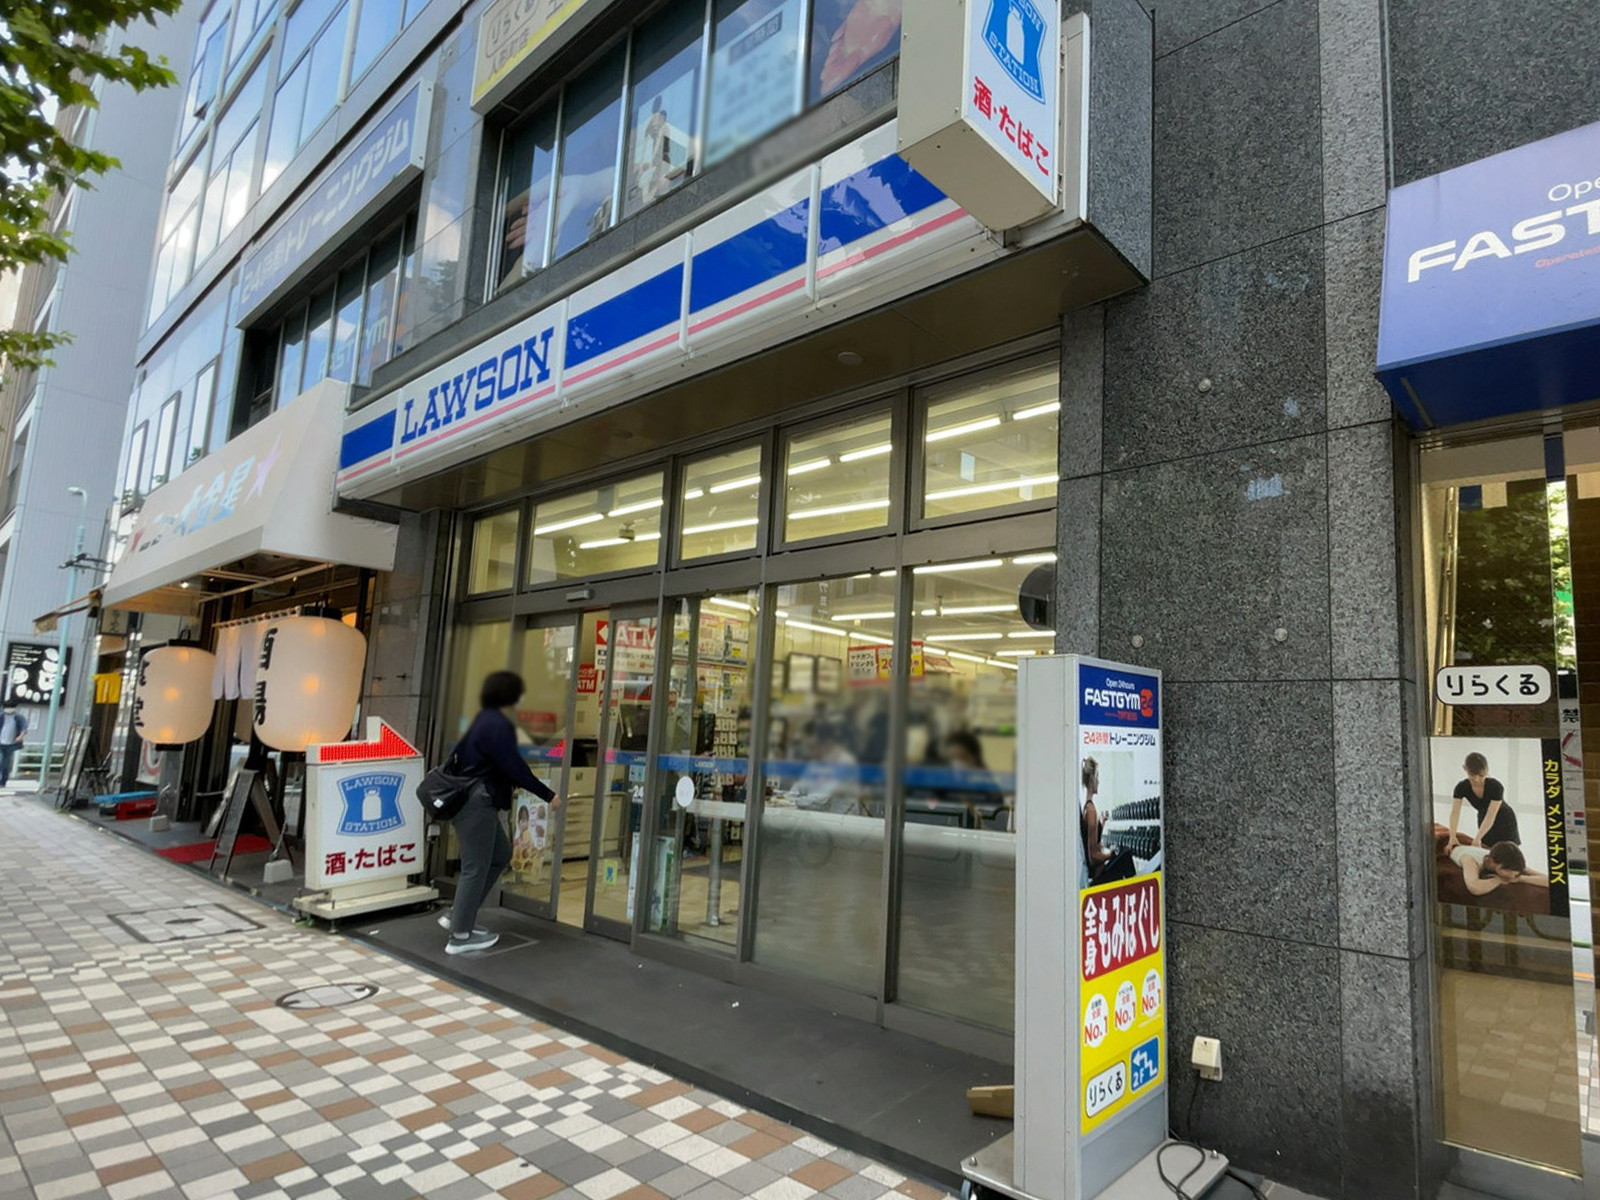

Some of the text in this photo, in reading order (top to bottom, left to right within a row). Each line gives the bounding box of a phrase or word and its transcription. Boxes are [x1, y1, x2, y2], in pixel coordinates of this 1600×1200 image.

[988, 31, 1040, 93] STATION
[974, 76, 1049, 176] 酒・たばこ
[1407, 199, 1600, 283] FAST
[401, 326, 555, 445] LAWSON
[616, 625, 657, 649] ATM
[1084, 687, 1141, 711] FASTGYM
[1446, 673, 1540, 696] りらくる
[344, 775, 400, 792] LAWSON
[343, 815, 399, 832] STATION
[1544, 758, 1567, 885] カラダ メンテナンス
[325, 843, 416, 876] 酒・たばこ
[1084, 896, 1098, 977] 全身
[1098, 885, 1160, 970] もみほぐし
[1114, 1000, 1137, 1029] No.1
[1142, 987, 1162, 1014] No.1
[1084, 1014, 1108, 1045] No.1
[1089, 1069, 1124, 1108] りらくる
[1132, 1068, 1145, 1090] 2F
